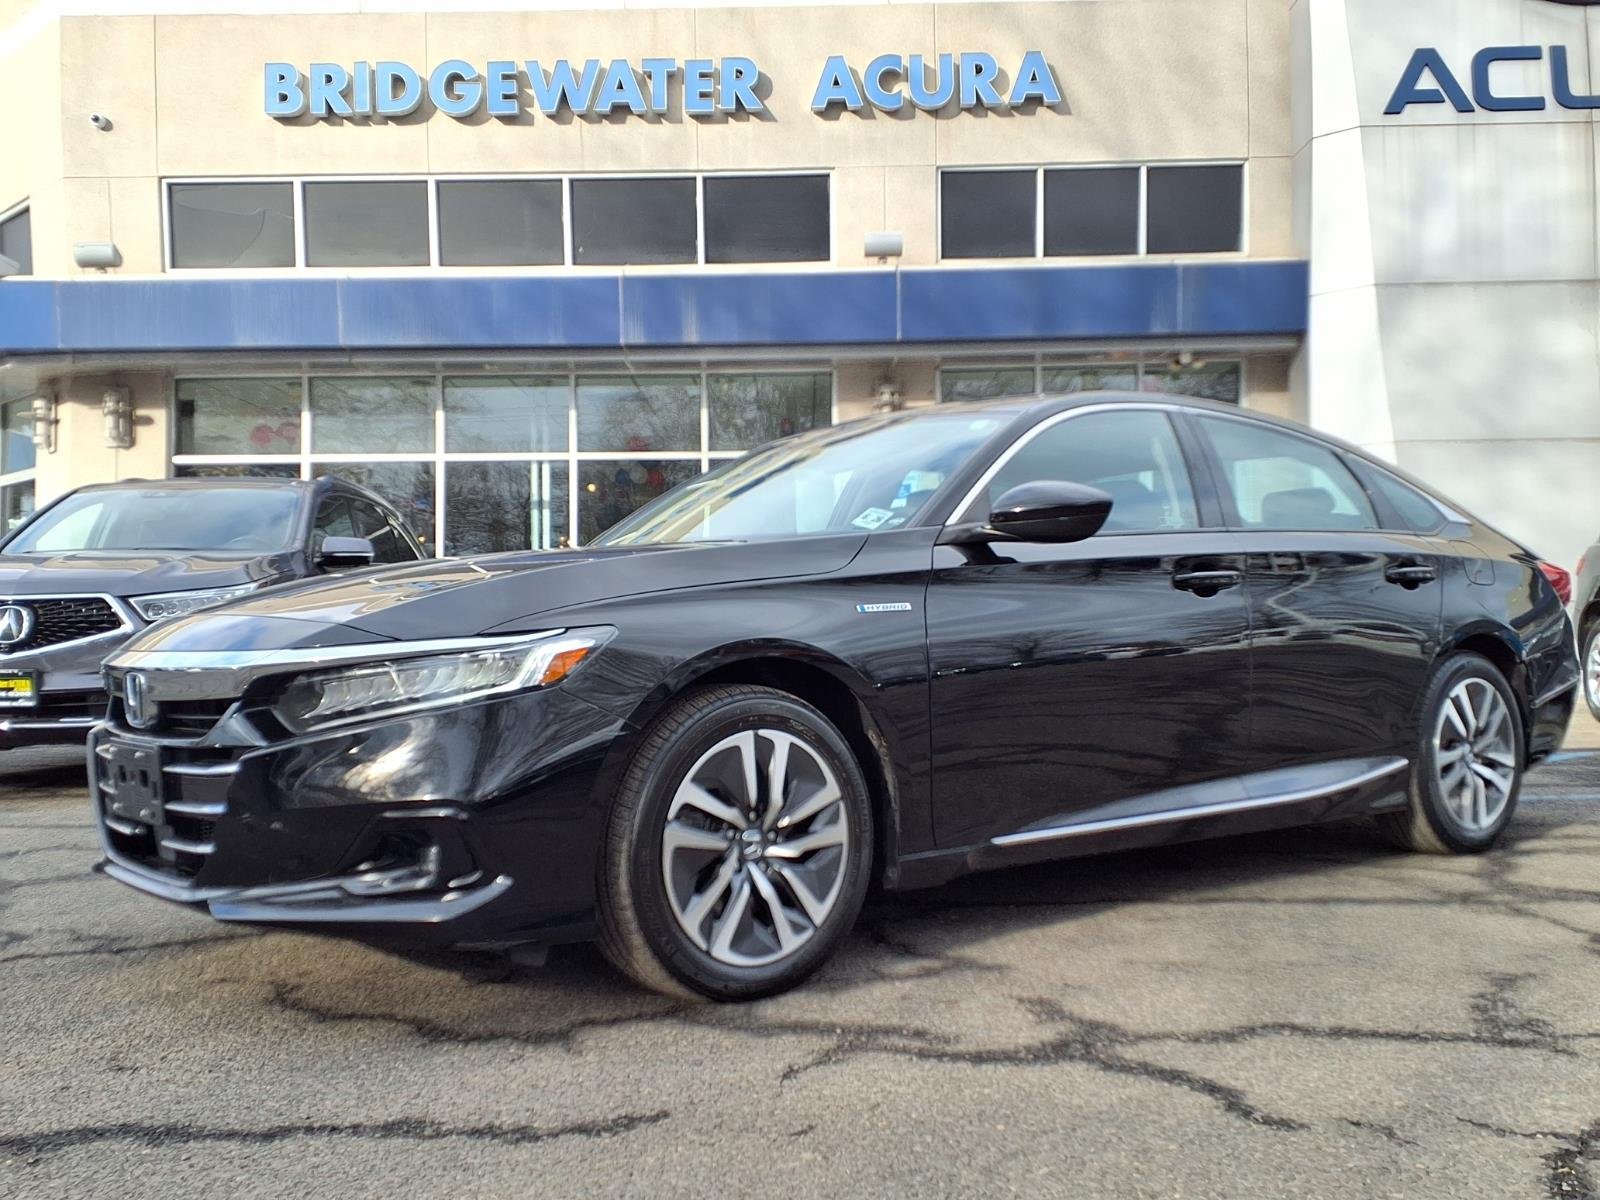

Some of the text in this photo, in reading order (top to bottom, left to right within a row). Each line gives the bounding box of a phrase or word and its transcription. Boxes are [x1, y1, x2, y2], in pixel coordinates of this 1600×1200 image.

[263, 49, 1062, 118] BRIDGEWATER ACURA
[866, 603, 908, 611] HYBRID
